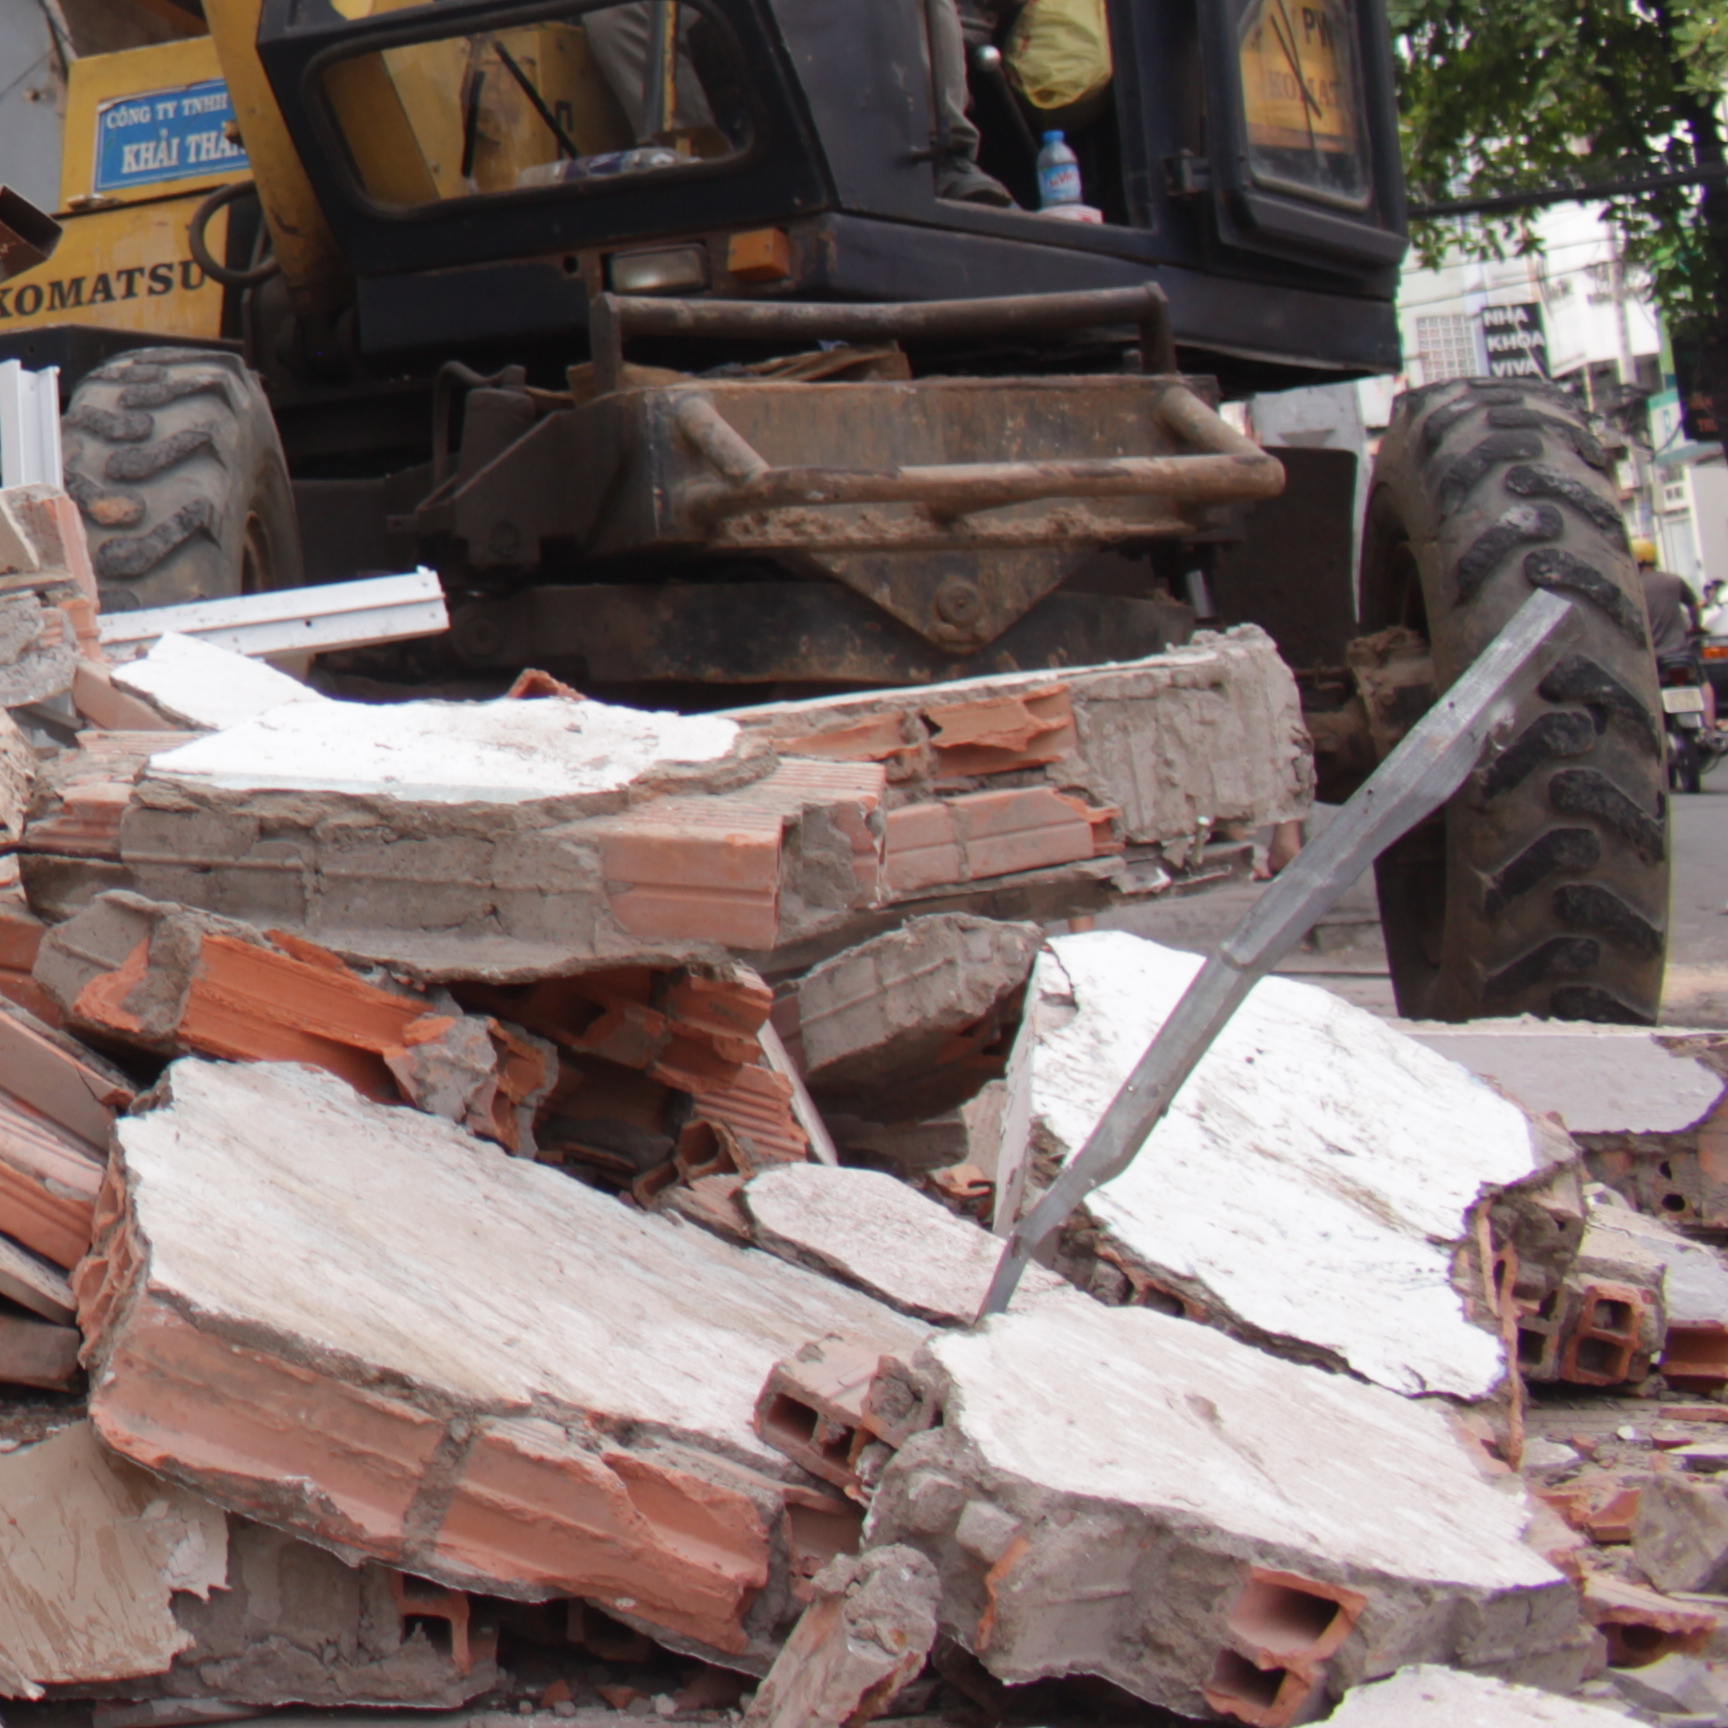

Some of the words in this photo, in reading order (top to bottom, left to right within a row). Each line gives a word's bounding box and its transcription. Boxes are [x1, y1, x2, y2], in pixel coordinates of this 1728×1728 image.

[106, 106, 151, 129] CÔNG
[156, 101, 178, 121] TY
[182, 92, 228, 116] TNHH
[122, 128, 181, 174] KHẢI
[1484, 306, 1529, 328] NHA
[1487, 330, 1546, 353] KHOA
[1491, 358, 1541, 379] VIVA
